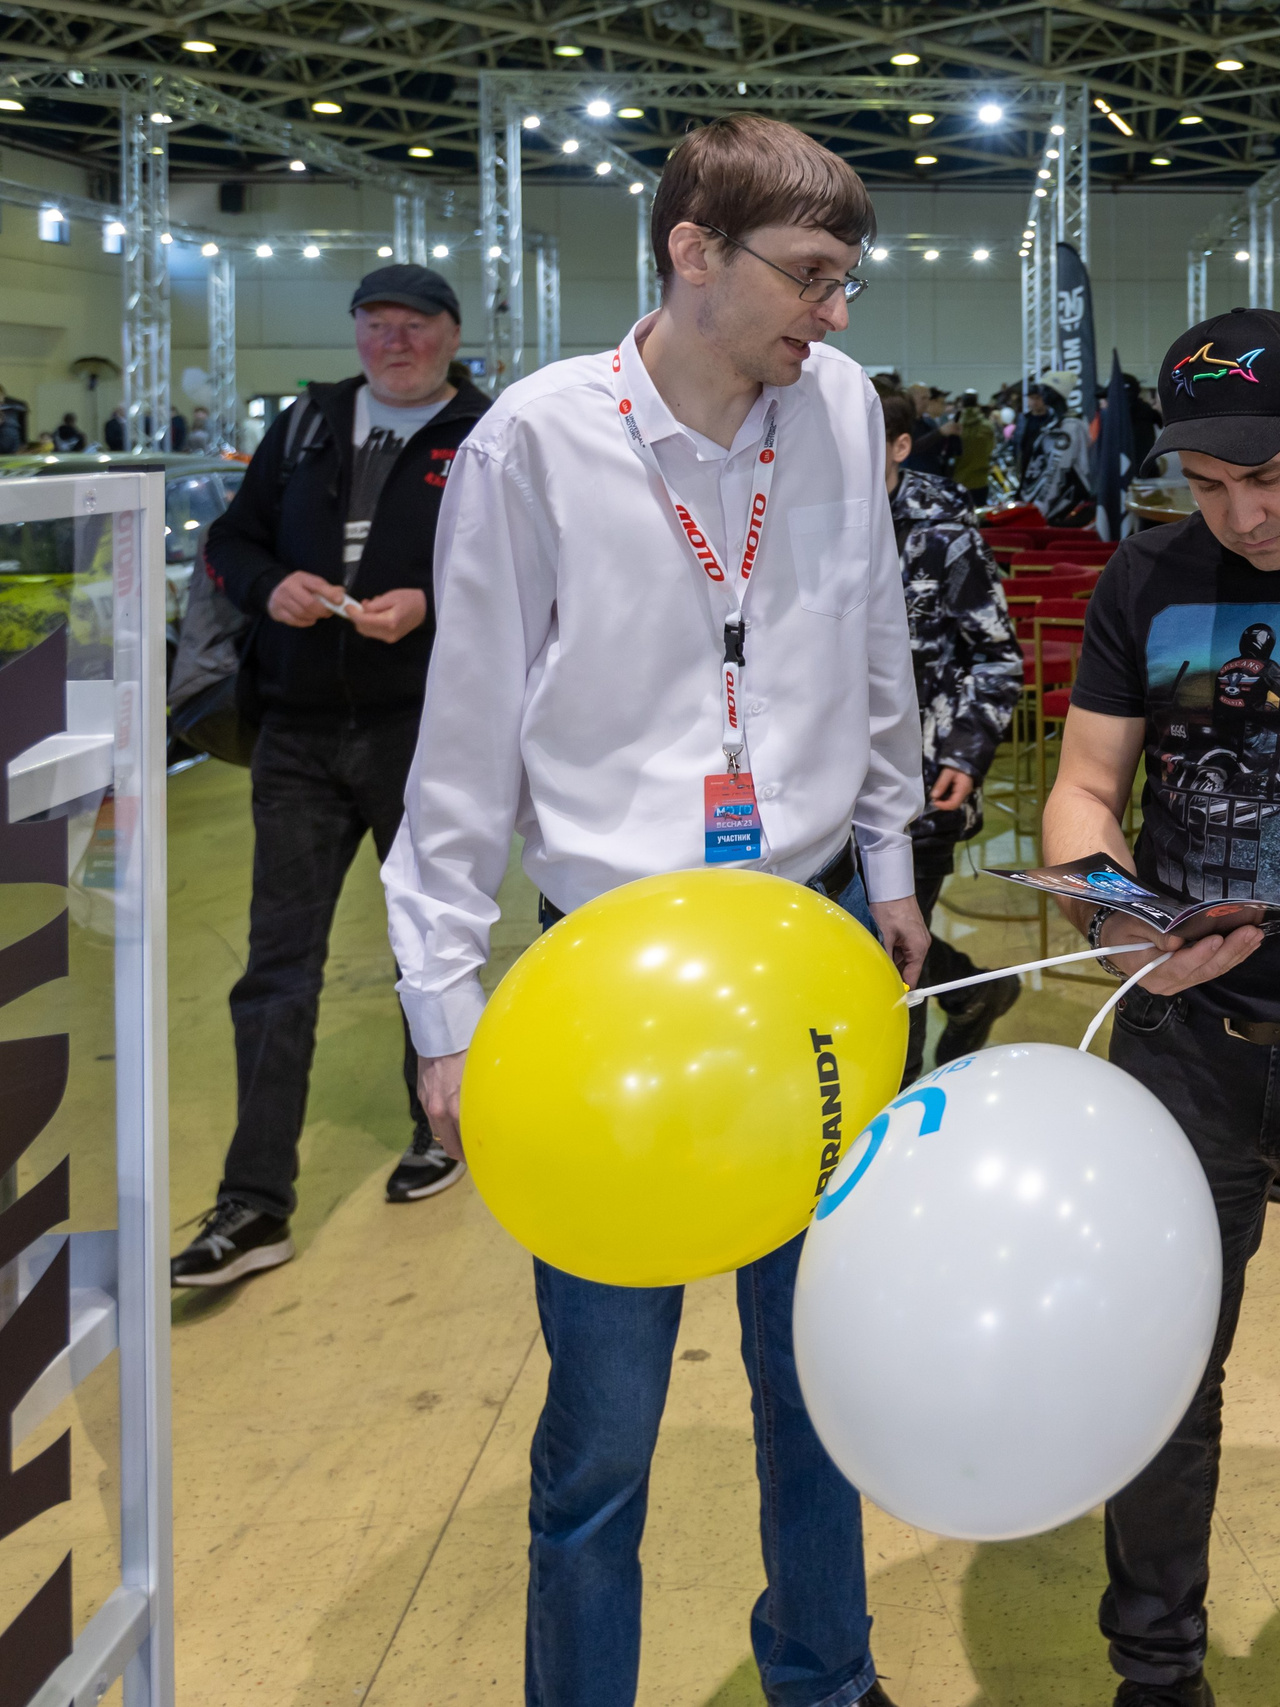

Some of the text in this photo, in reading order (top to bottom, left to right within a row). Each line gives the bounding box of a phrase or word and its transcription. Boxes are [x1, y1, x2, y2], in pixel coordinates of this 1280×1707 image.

[676, 504, 725, 582] MOTO
[741, 492, 766, 579] MOTO
[726, 671, 738, 728] MOTO
[717, 834, 751, 844] УЧАСТНИК
[809, 1028, 842, 1214] BRANDT
